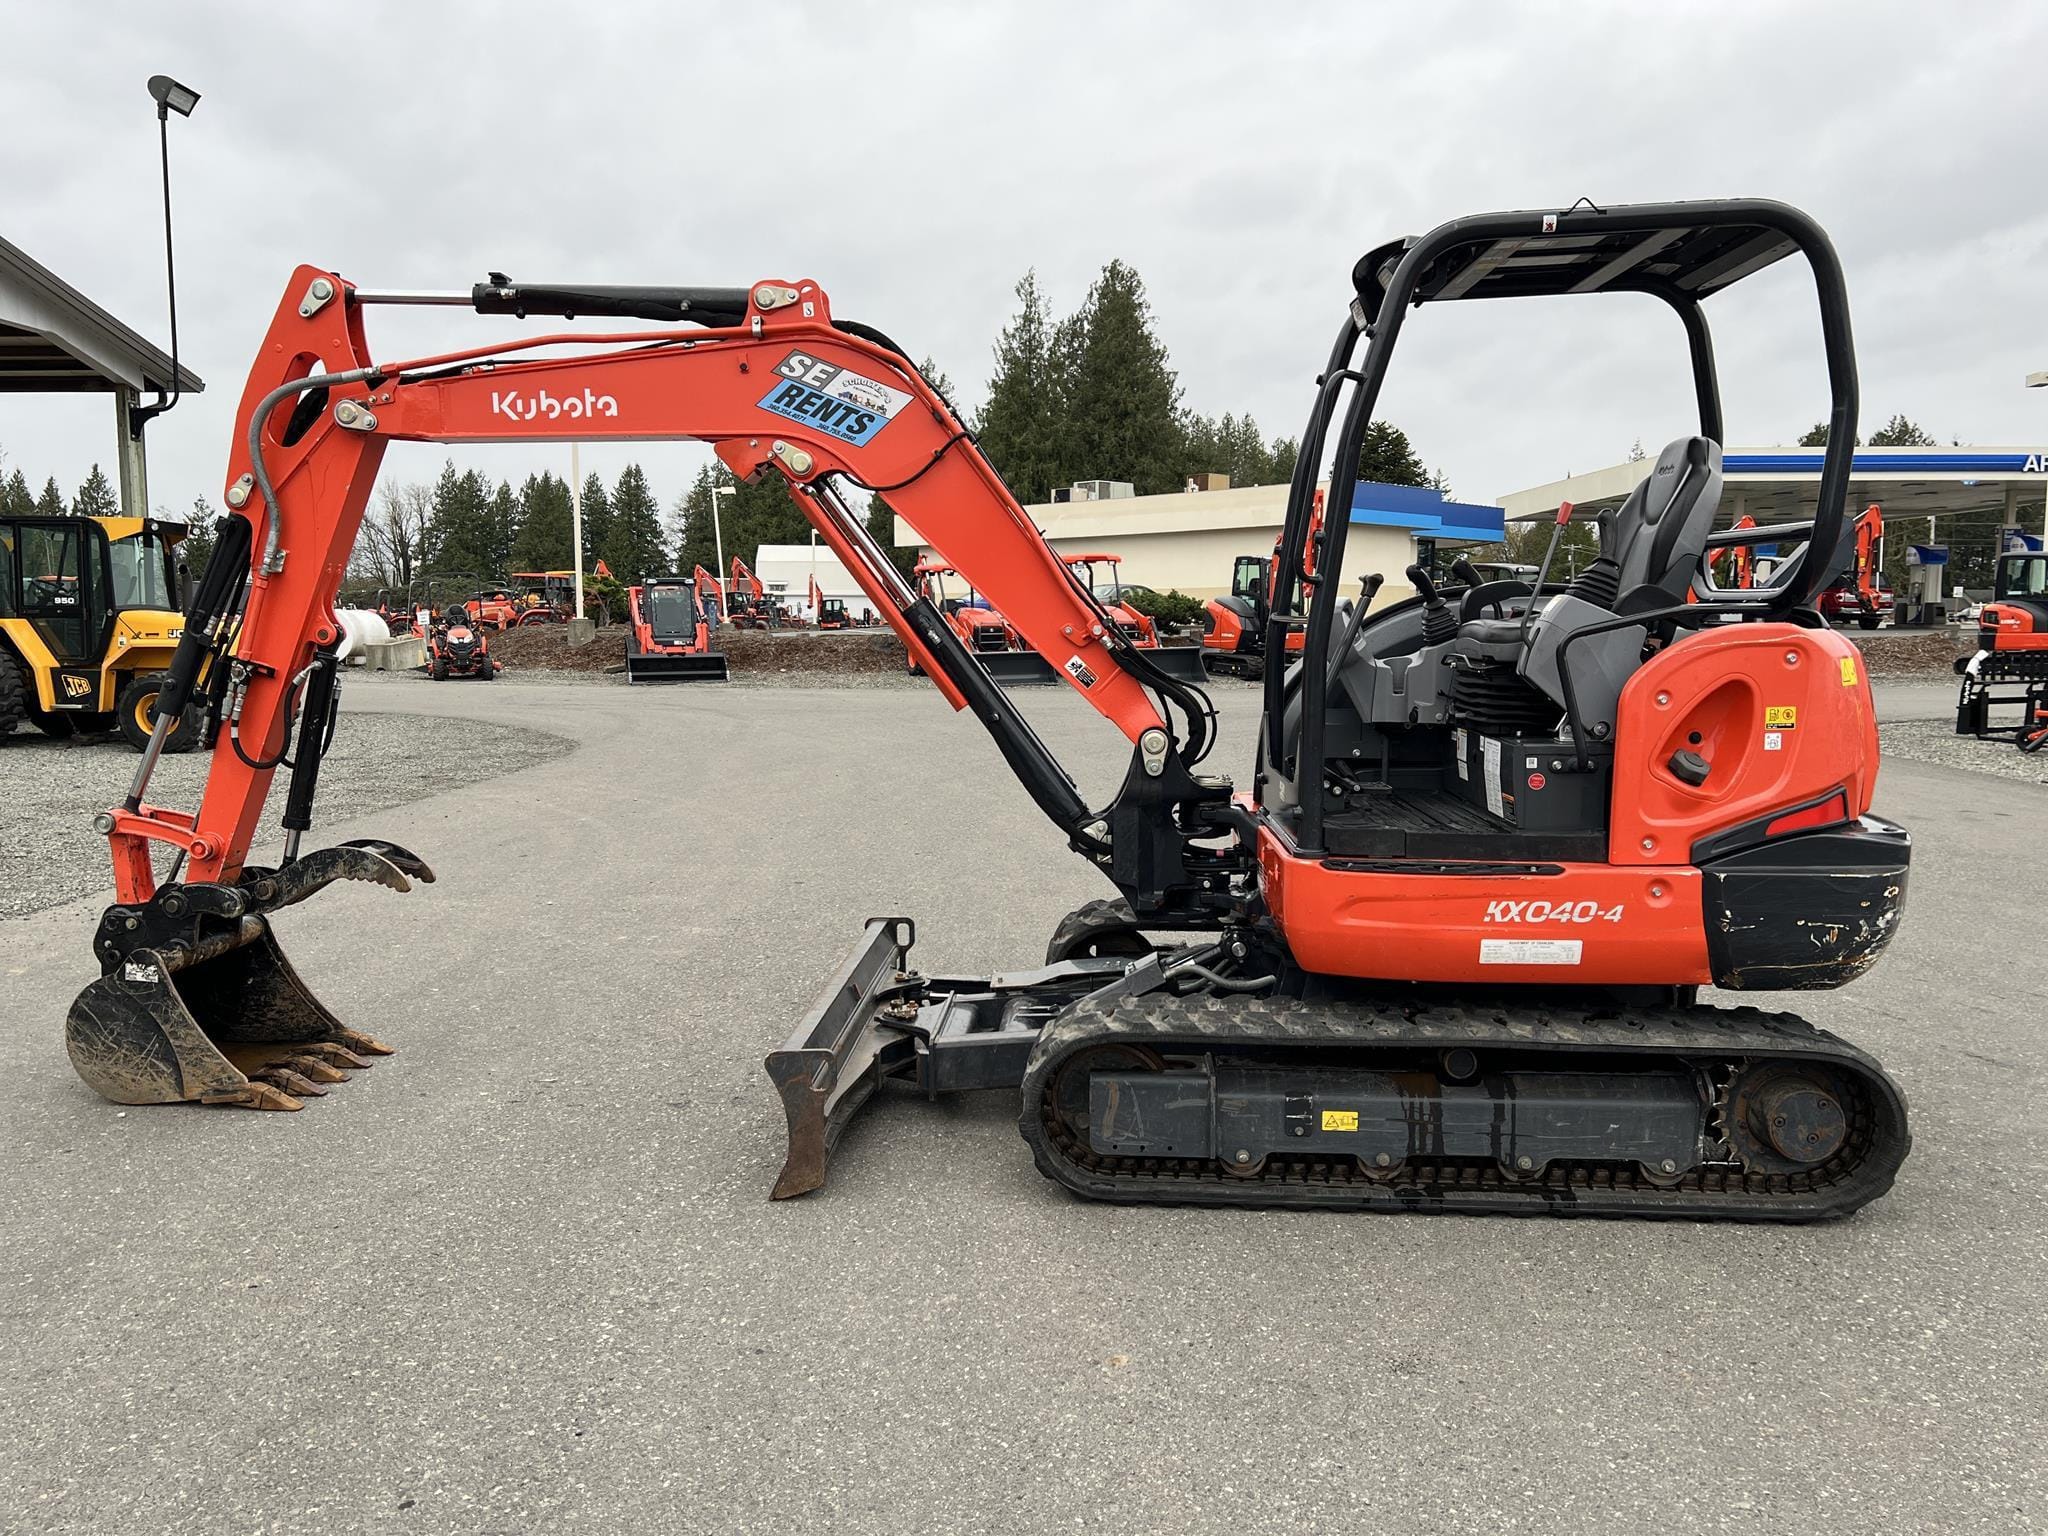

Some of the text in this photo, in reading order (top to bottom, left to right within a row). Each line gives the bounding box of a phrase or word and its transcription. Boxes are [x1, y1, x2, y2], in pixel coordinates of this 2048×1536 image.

[780, 355, 836, 387] SE
[491, 388, 618, 421] Kubota
[773, 383, 876, 435] RENTS
[168, 629, 185, 638] JC
[67, 677, 89, 696] JCB
[1482, 900, 1624, 923] KX040-4
